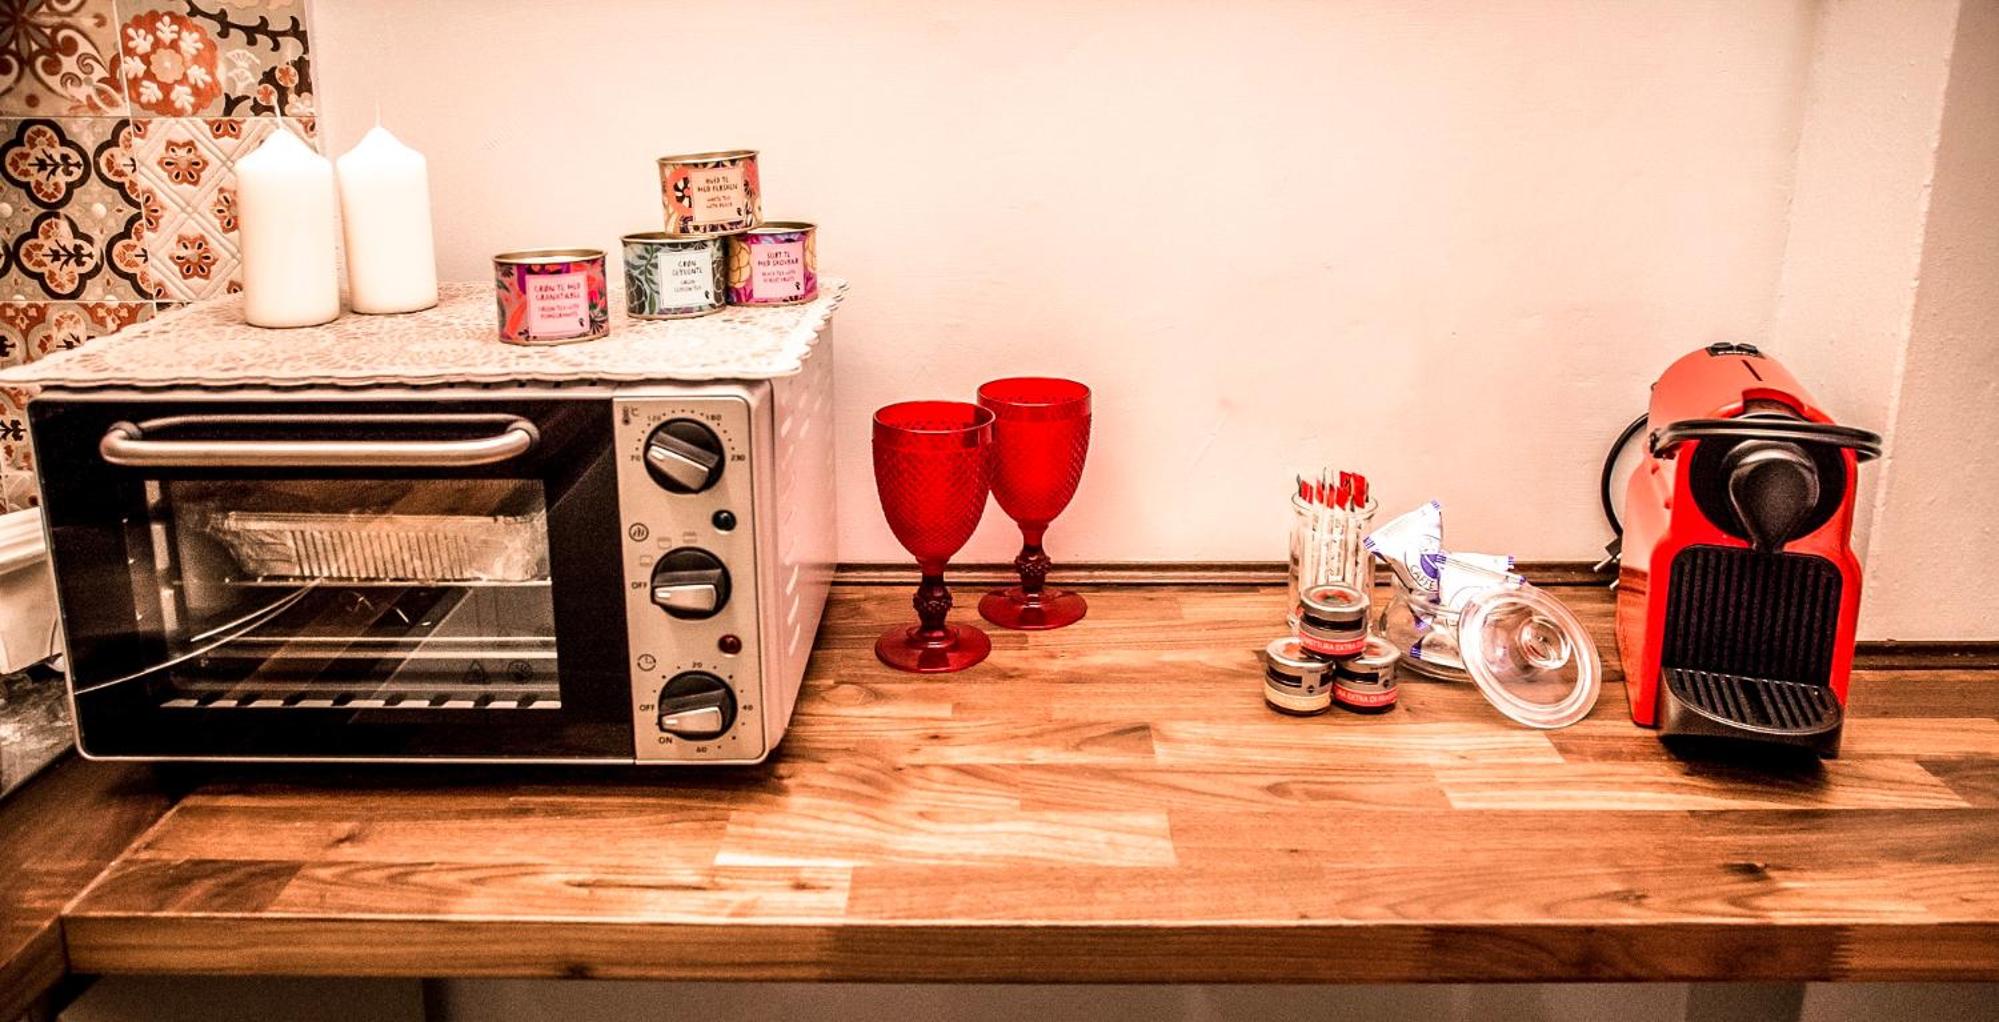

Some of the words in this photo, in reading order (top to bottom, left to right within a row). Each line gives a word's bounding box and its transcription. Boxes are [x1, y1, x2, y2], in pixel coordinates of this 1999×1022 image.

[631, 581, 648, 590] OFF
[639, 703, 655, 712] OFF
[657, 736, 673, 745] ON
